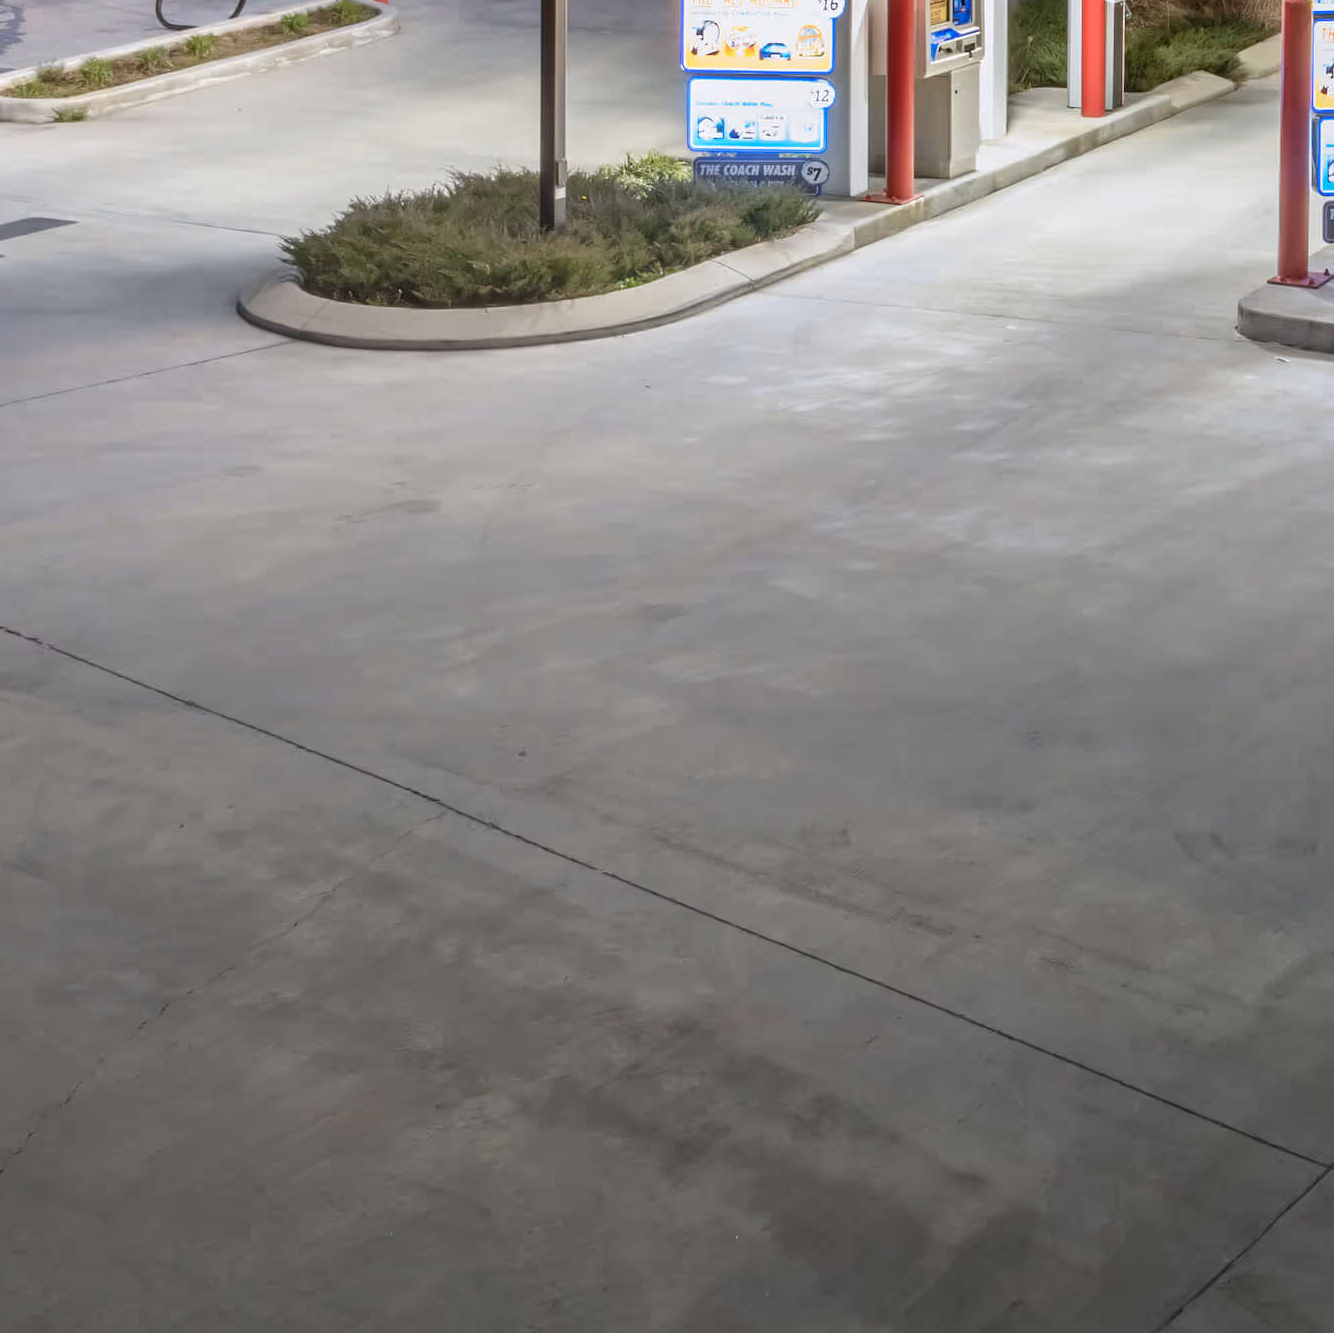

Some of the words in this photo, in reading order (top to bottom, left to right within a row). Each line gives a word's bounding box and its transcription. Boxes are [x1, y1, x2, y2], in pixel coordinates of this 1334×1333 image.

[810, 88, 829, 102] $12
[700, 163, 720, 176] THE
[723, 164, 760, 176] COACH
[762, 164, 796, 176] WASH
[806, 166, 822, 182] $7
